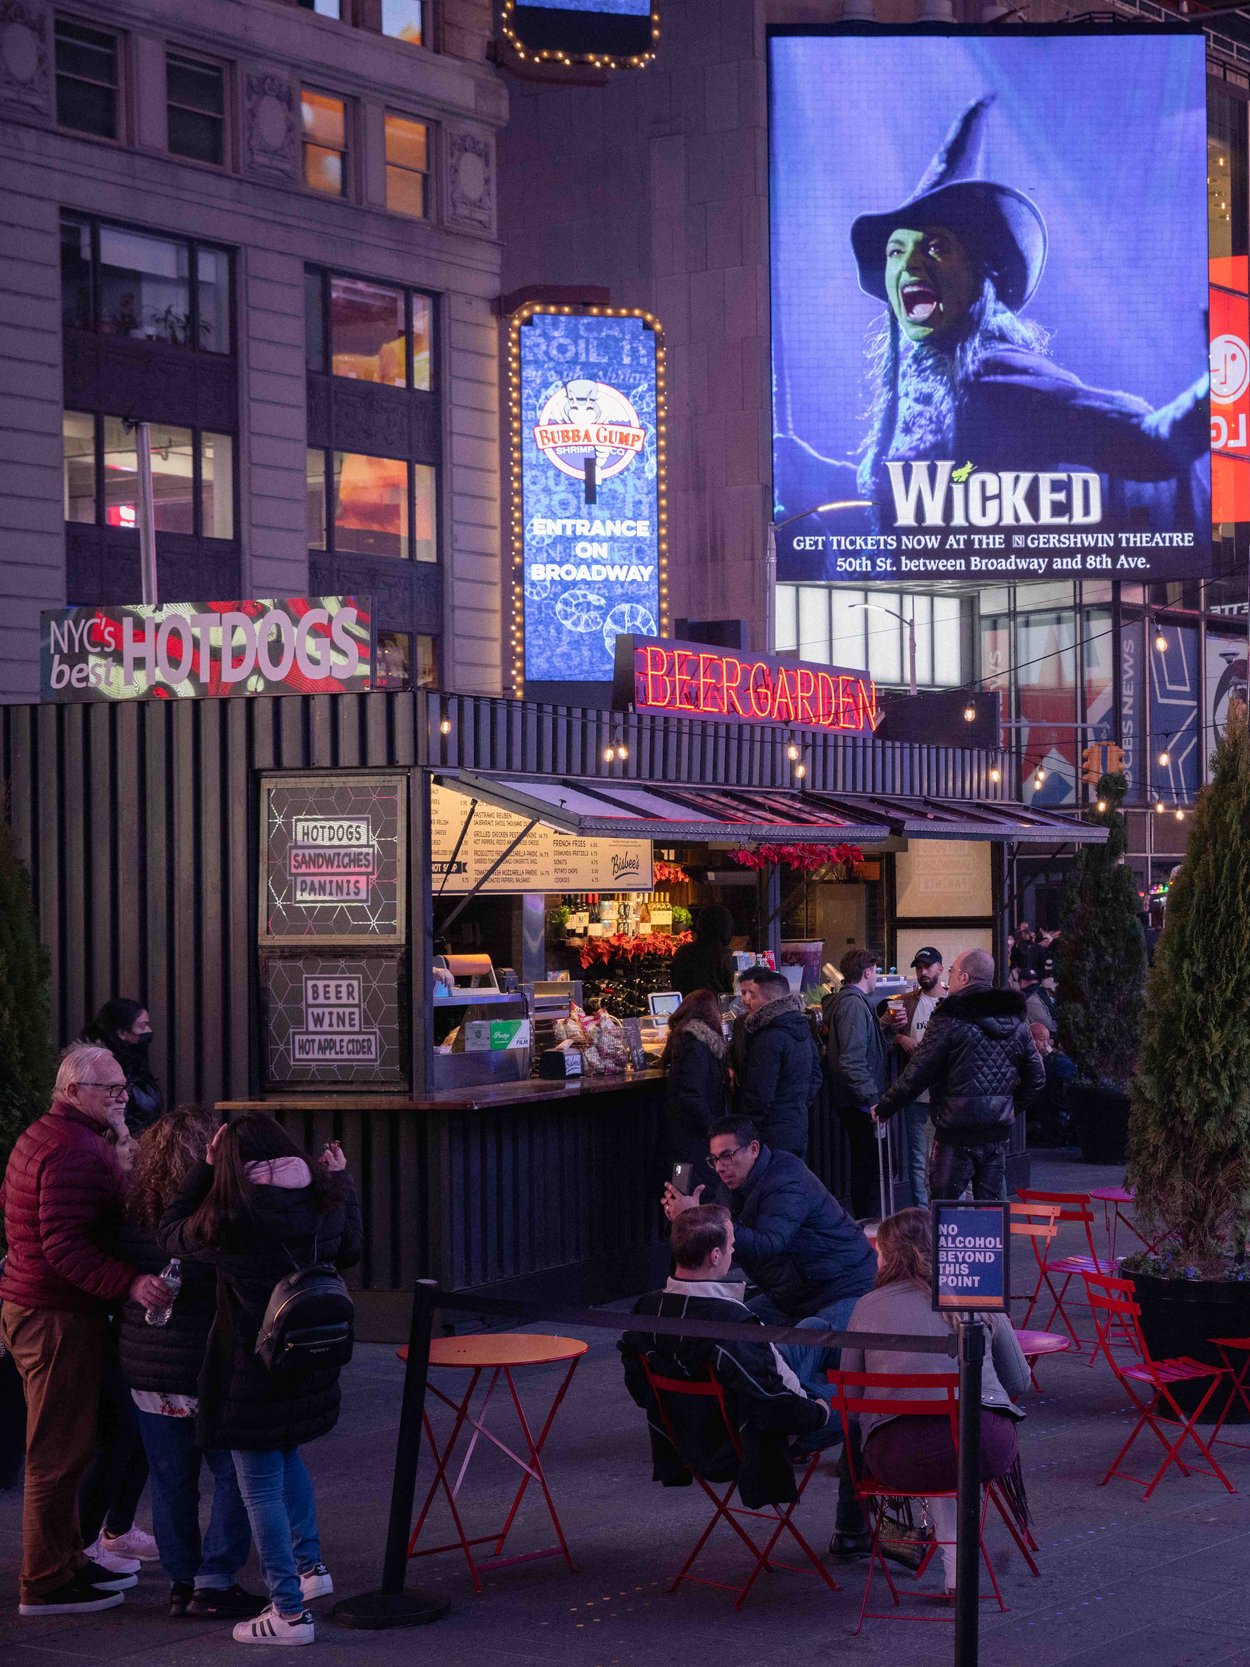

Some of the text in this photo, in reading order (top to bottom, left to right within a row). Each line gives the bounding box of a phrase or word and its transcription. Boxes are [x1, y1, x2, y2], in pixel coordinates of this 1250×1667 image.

[539, 426, 642, 447] BUBBA GUMP
[533, 518, 650, 537] ENTRANCE
[575, 541, 608, 559] ON
[793, 536, 825, 551] GET
[829, 535, 897, 551] TICKETS
[901, 535, 941, 550] NOW
[945, 534, 968, 549] AT
[970, 534, 1005, 549] THE
[1027, 533, 1114, 549] GERSHWIN
[1118, 532, 1195, 548] THEATRE
[530, 563, 654, 582] BROADWAY
[836, 554, 1151, 574] 50th St. between Broadway and 8th Ave.
[50, 619, 116, 655] NYC's
[50, 607, 358, 690] best HOTDOGS
[646, 646, 878, 732] BEER GARDEN
[302, 825, 361, 842] HOTDOGS
[572, 840, 586, 848] FRIES
[293, 852, 371, 869] SANDWICHES
[300, 879, 361, 897] PANINIS
[311, 983, 356, 1001] BEER
[311, 1011, 356, 1028] WINE
[298, 1038, 373, 1056] HOT APPLE CIDER
[938, 1224, 958, 1235] NO
[938, 1236, 1003, 1249] ALCOHOL
[938, 1251, 995, 1263] BEYOND
[938, 1263, 969, 1275] THIS
[938, 1275, 980, 1287] POINT
